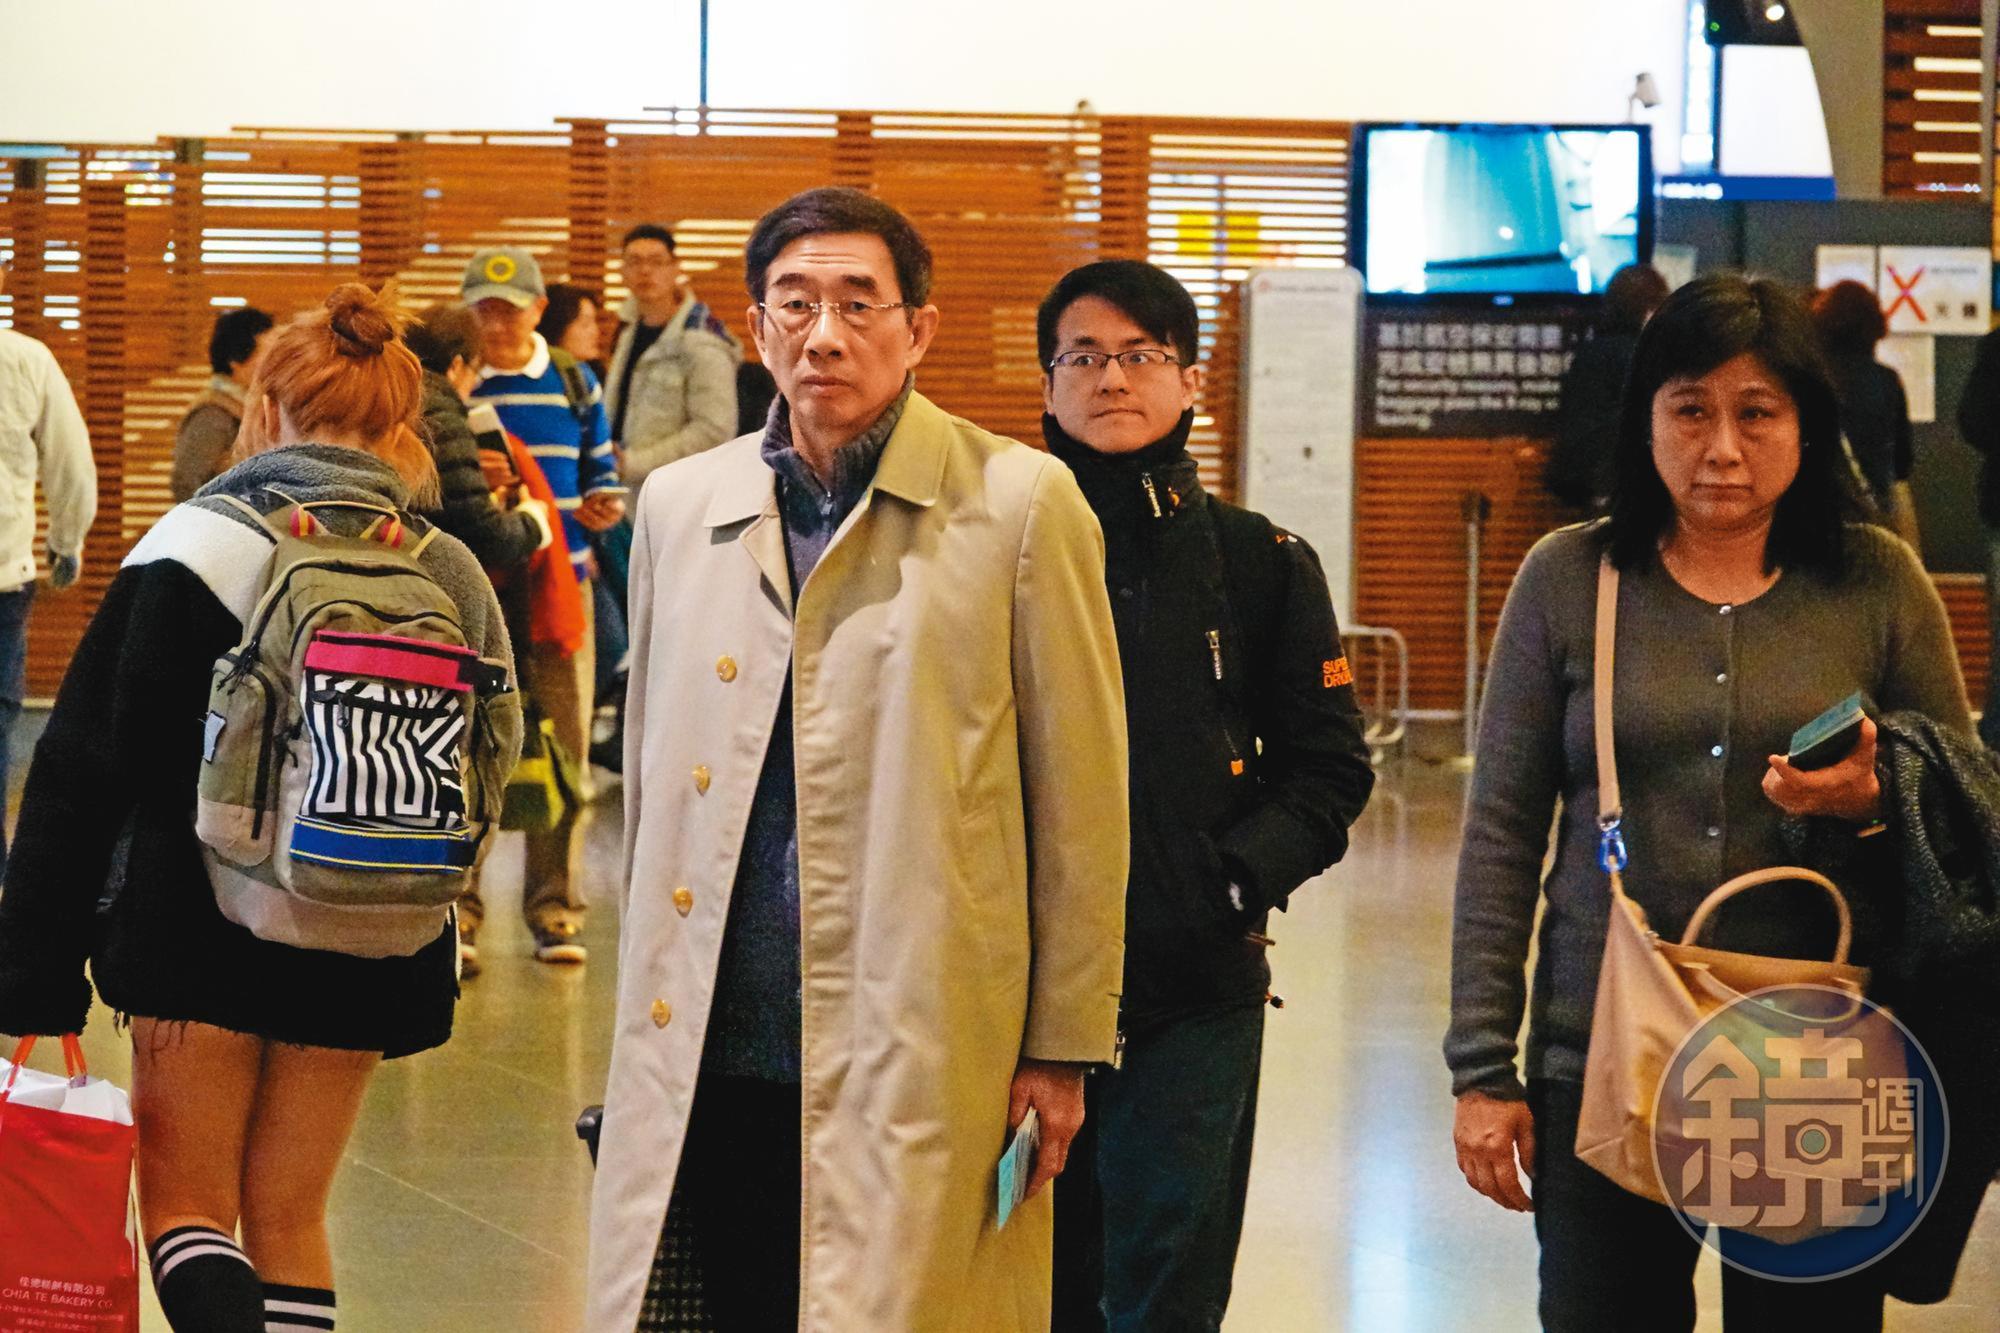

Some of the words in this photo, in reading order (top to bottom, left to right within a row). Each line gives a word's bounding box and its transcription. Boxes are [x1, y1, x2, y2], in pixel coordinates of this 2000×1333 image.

[2, 1288, 31, 1300] CHIA
[35, 1291, 48, 1302] TE
[51, 1293, 95, 1307] BAKERY
